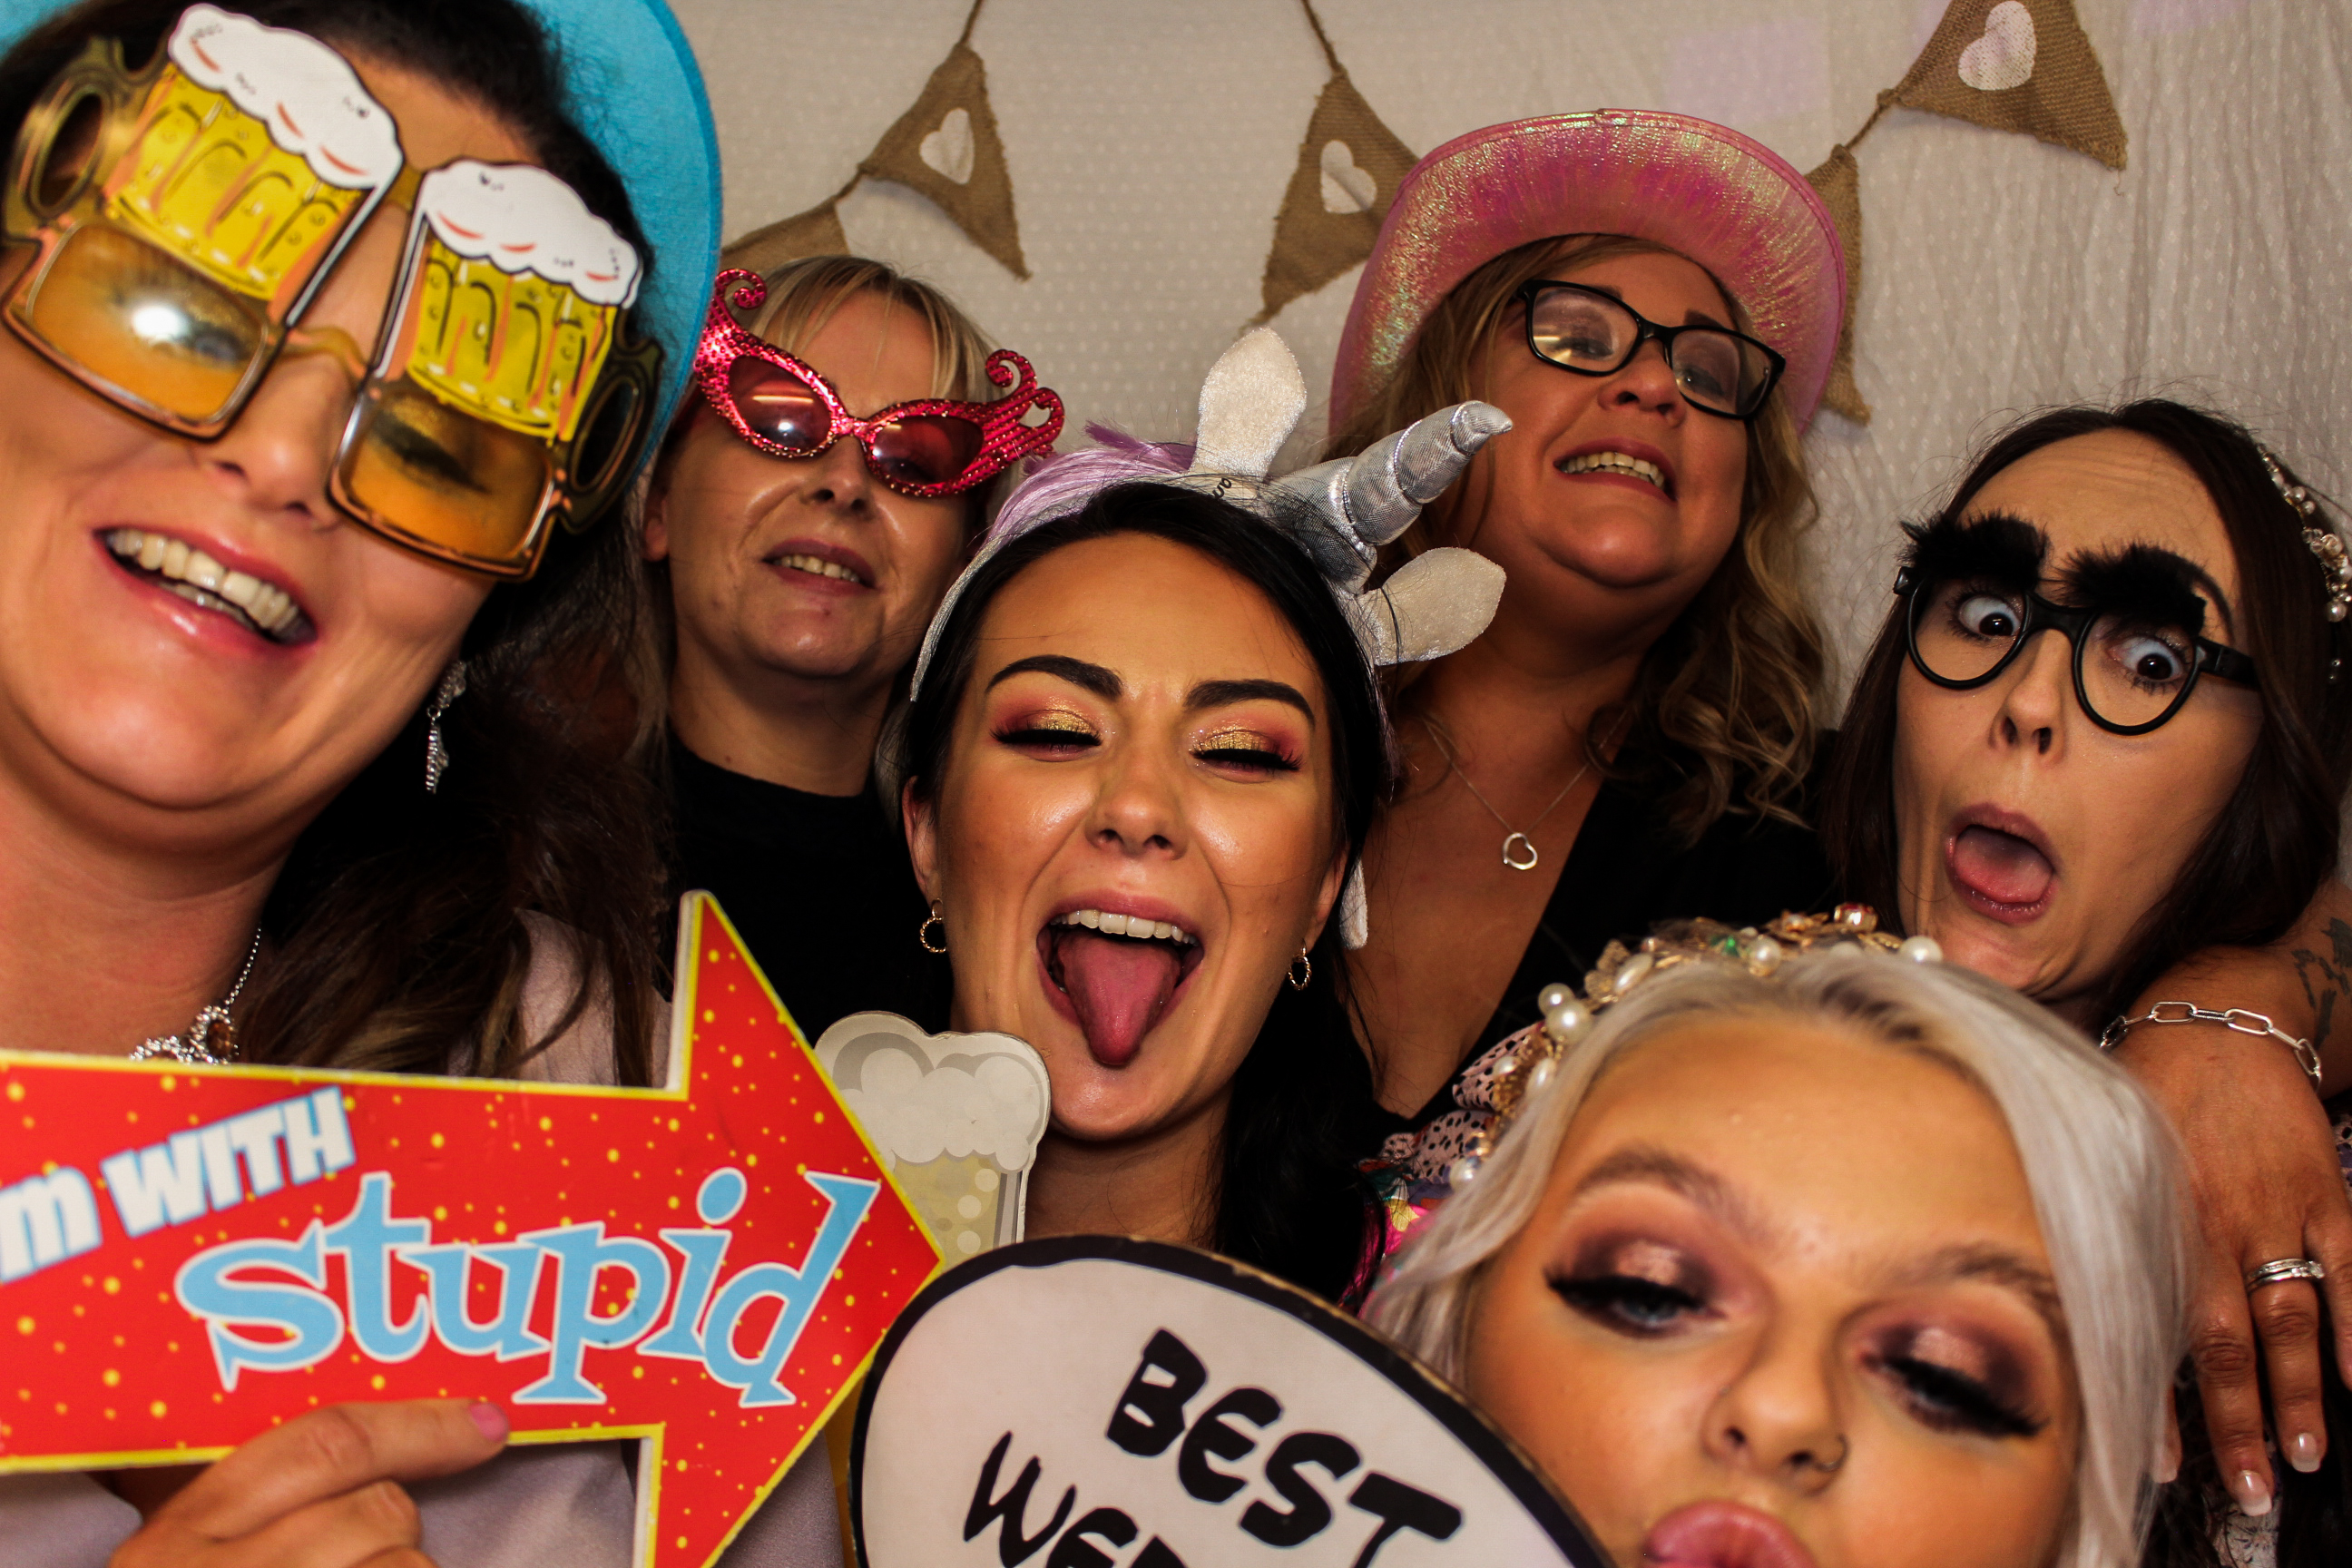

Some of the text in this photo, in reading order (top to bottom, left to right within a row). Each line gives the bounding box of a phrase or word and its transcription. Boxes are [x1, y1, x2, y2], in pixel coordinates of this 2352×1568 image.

[99, 1084, 356, 1239] WITH
[175, 1167, 881, 1408] stupid
[1105, 1328, 1463, 1568] BEST
